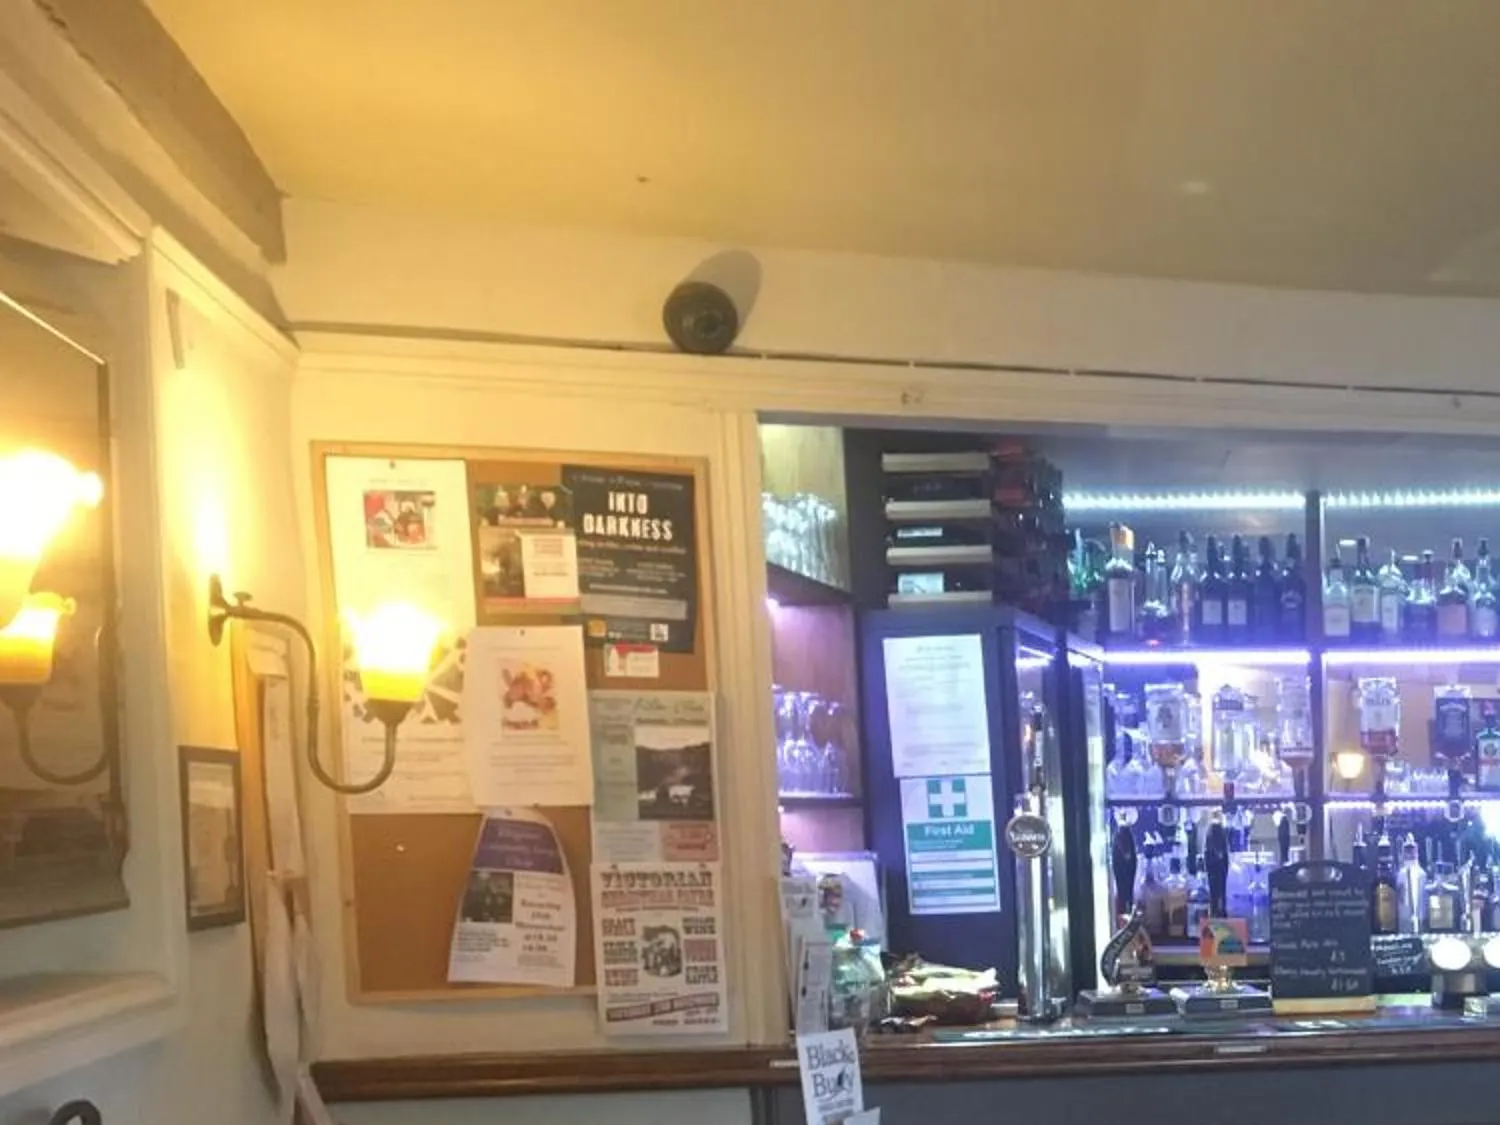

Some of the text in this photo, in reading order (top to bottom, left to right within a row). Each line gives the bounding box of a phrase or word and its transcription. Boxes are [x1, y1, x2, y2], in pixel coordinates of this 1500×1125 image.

[608, 491, 648, 515] INTO
[583, 513, 673, 541] DARKNESS
[924, 824, 975, 837] First Aid
